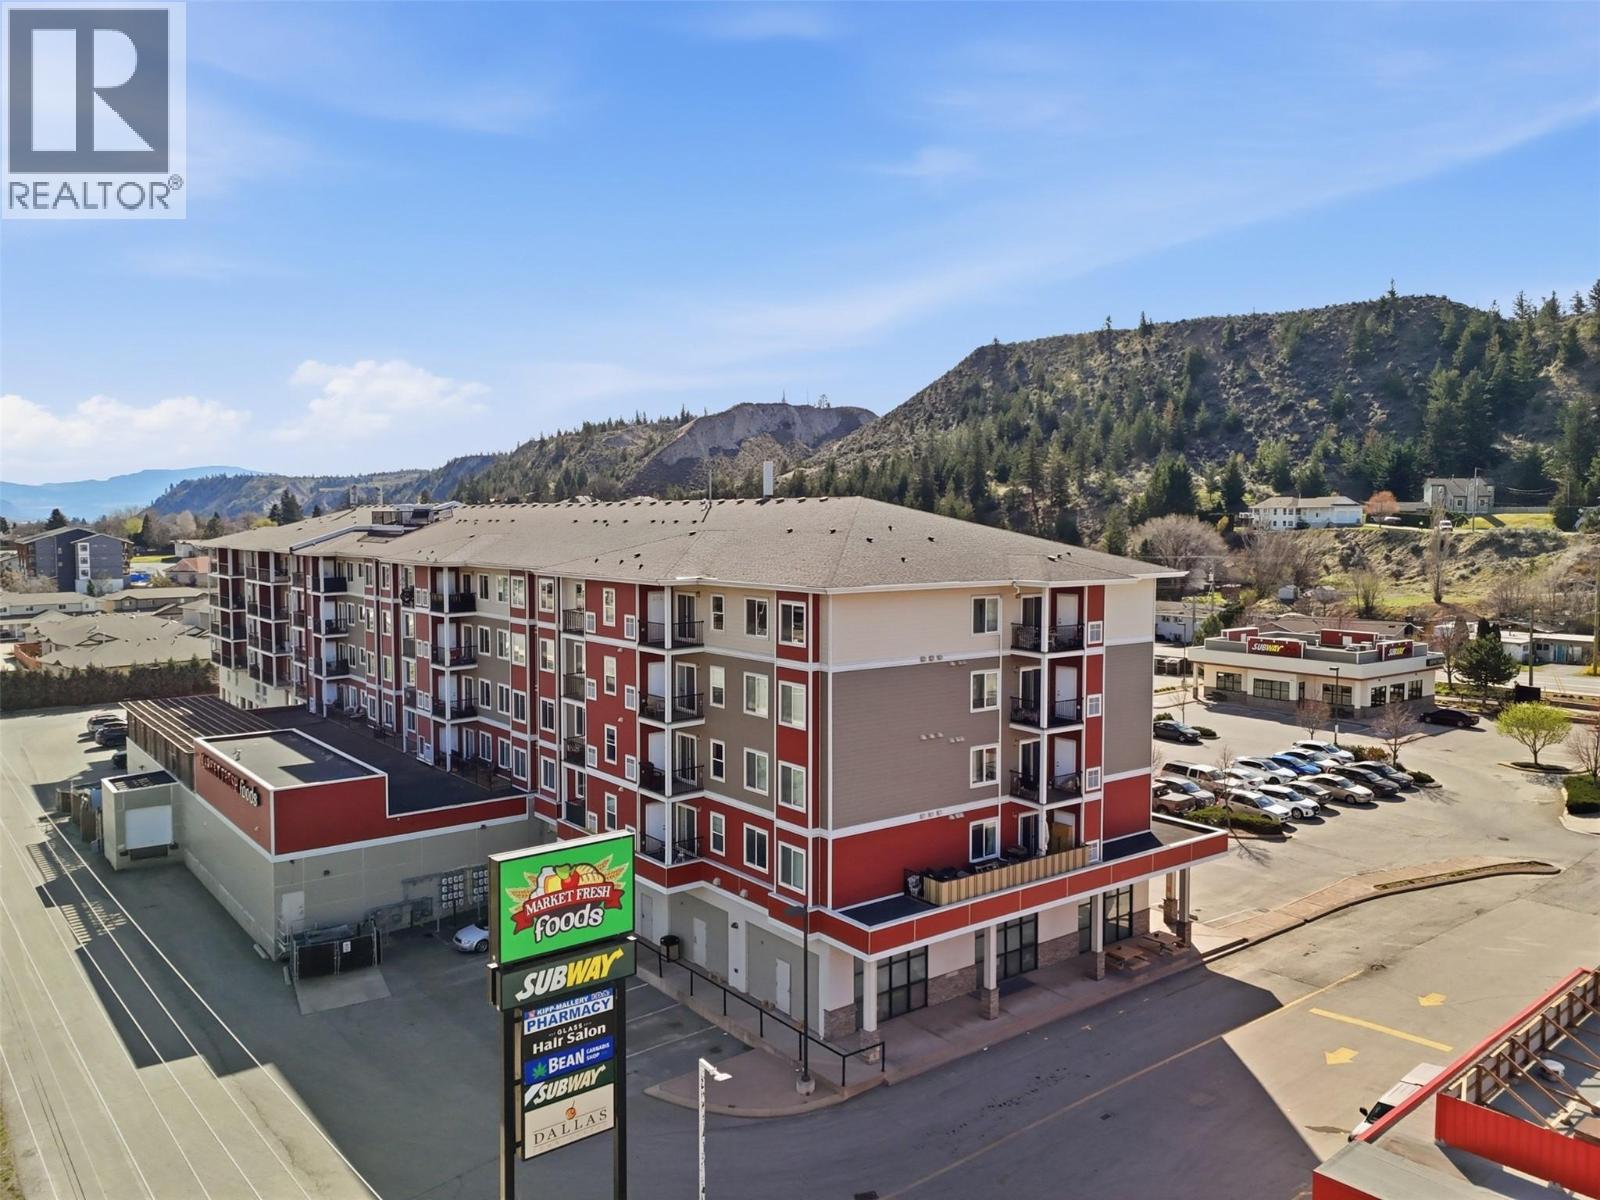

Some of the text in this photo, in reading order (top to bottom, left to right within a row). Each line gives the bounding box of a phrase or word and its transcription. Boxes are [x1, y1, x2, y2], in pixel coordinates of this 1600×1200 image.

[1251, 643, 1284, 652] SUBWAY
[525, 885, 611, 916] MARKET FRESH
[535, 903, 604, 942] foods
[515, 947, 624, 1002] SUBWAY
[527, 998, 610, 1032] PHARMACY
[533, 1024, 606, 1055] Hair Salon
[549, 1048, 585, 1074] BEAN
[533, 1064, 606, 1105] SUBWAY
[534, 1109, 607, 1145] DALLAS
